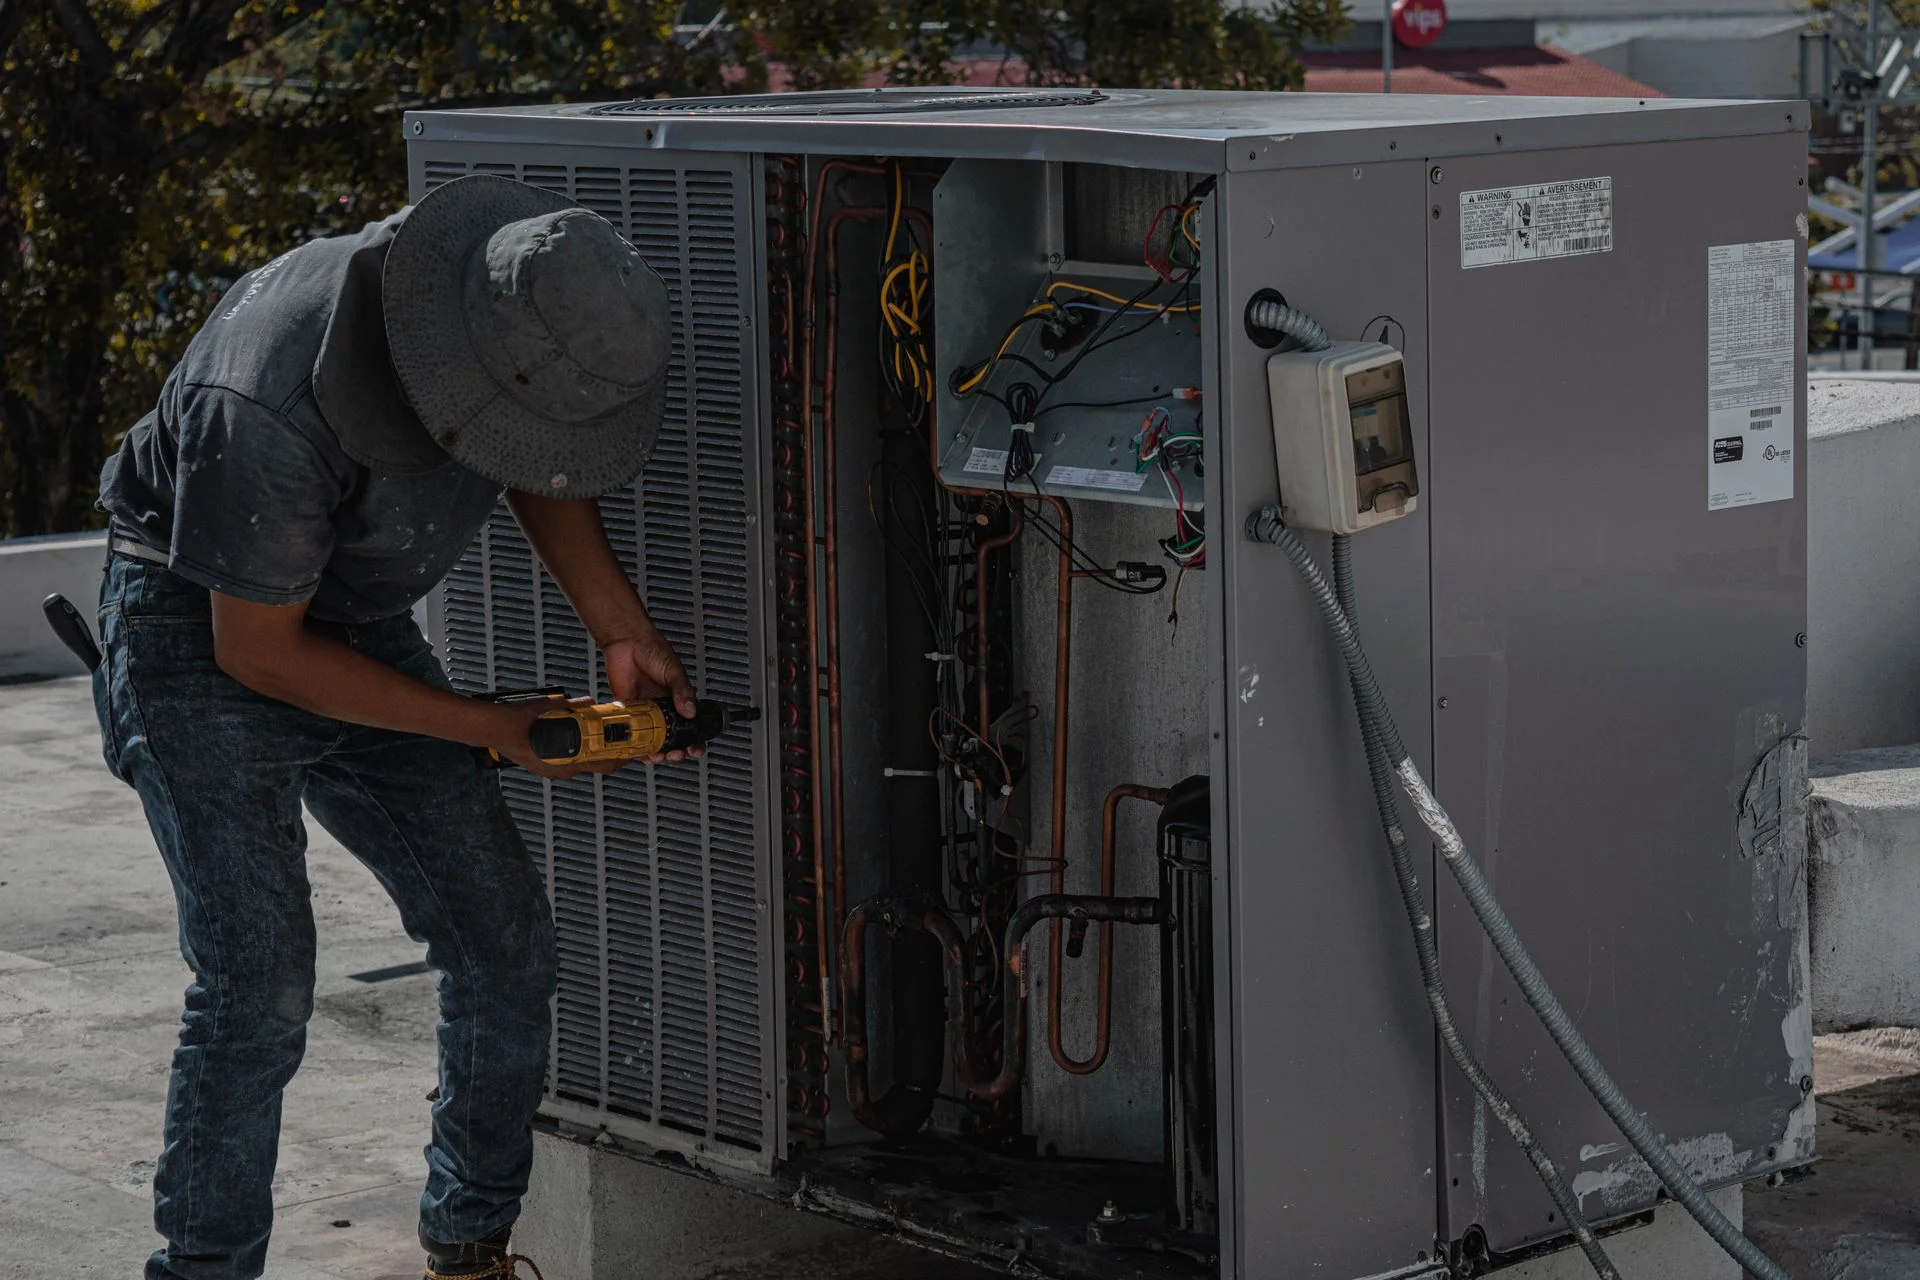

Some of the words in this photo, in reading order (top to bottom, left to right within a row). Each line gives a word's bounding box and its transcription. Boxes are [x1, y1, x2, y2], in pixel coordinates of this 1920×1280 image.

[1403, 4, 1441, 36] vips
[1547, 181, 1602, 194] AVERTISSEMENT
[1476, 191, 1512, 202] WARNING
